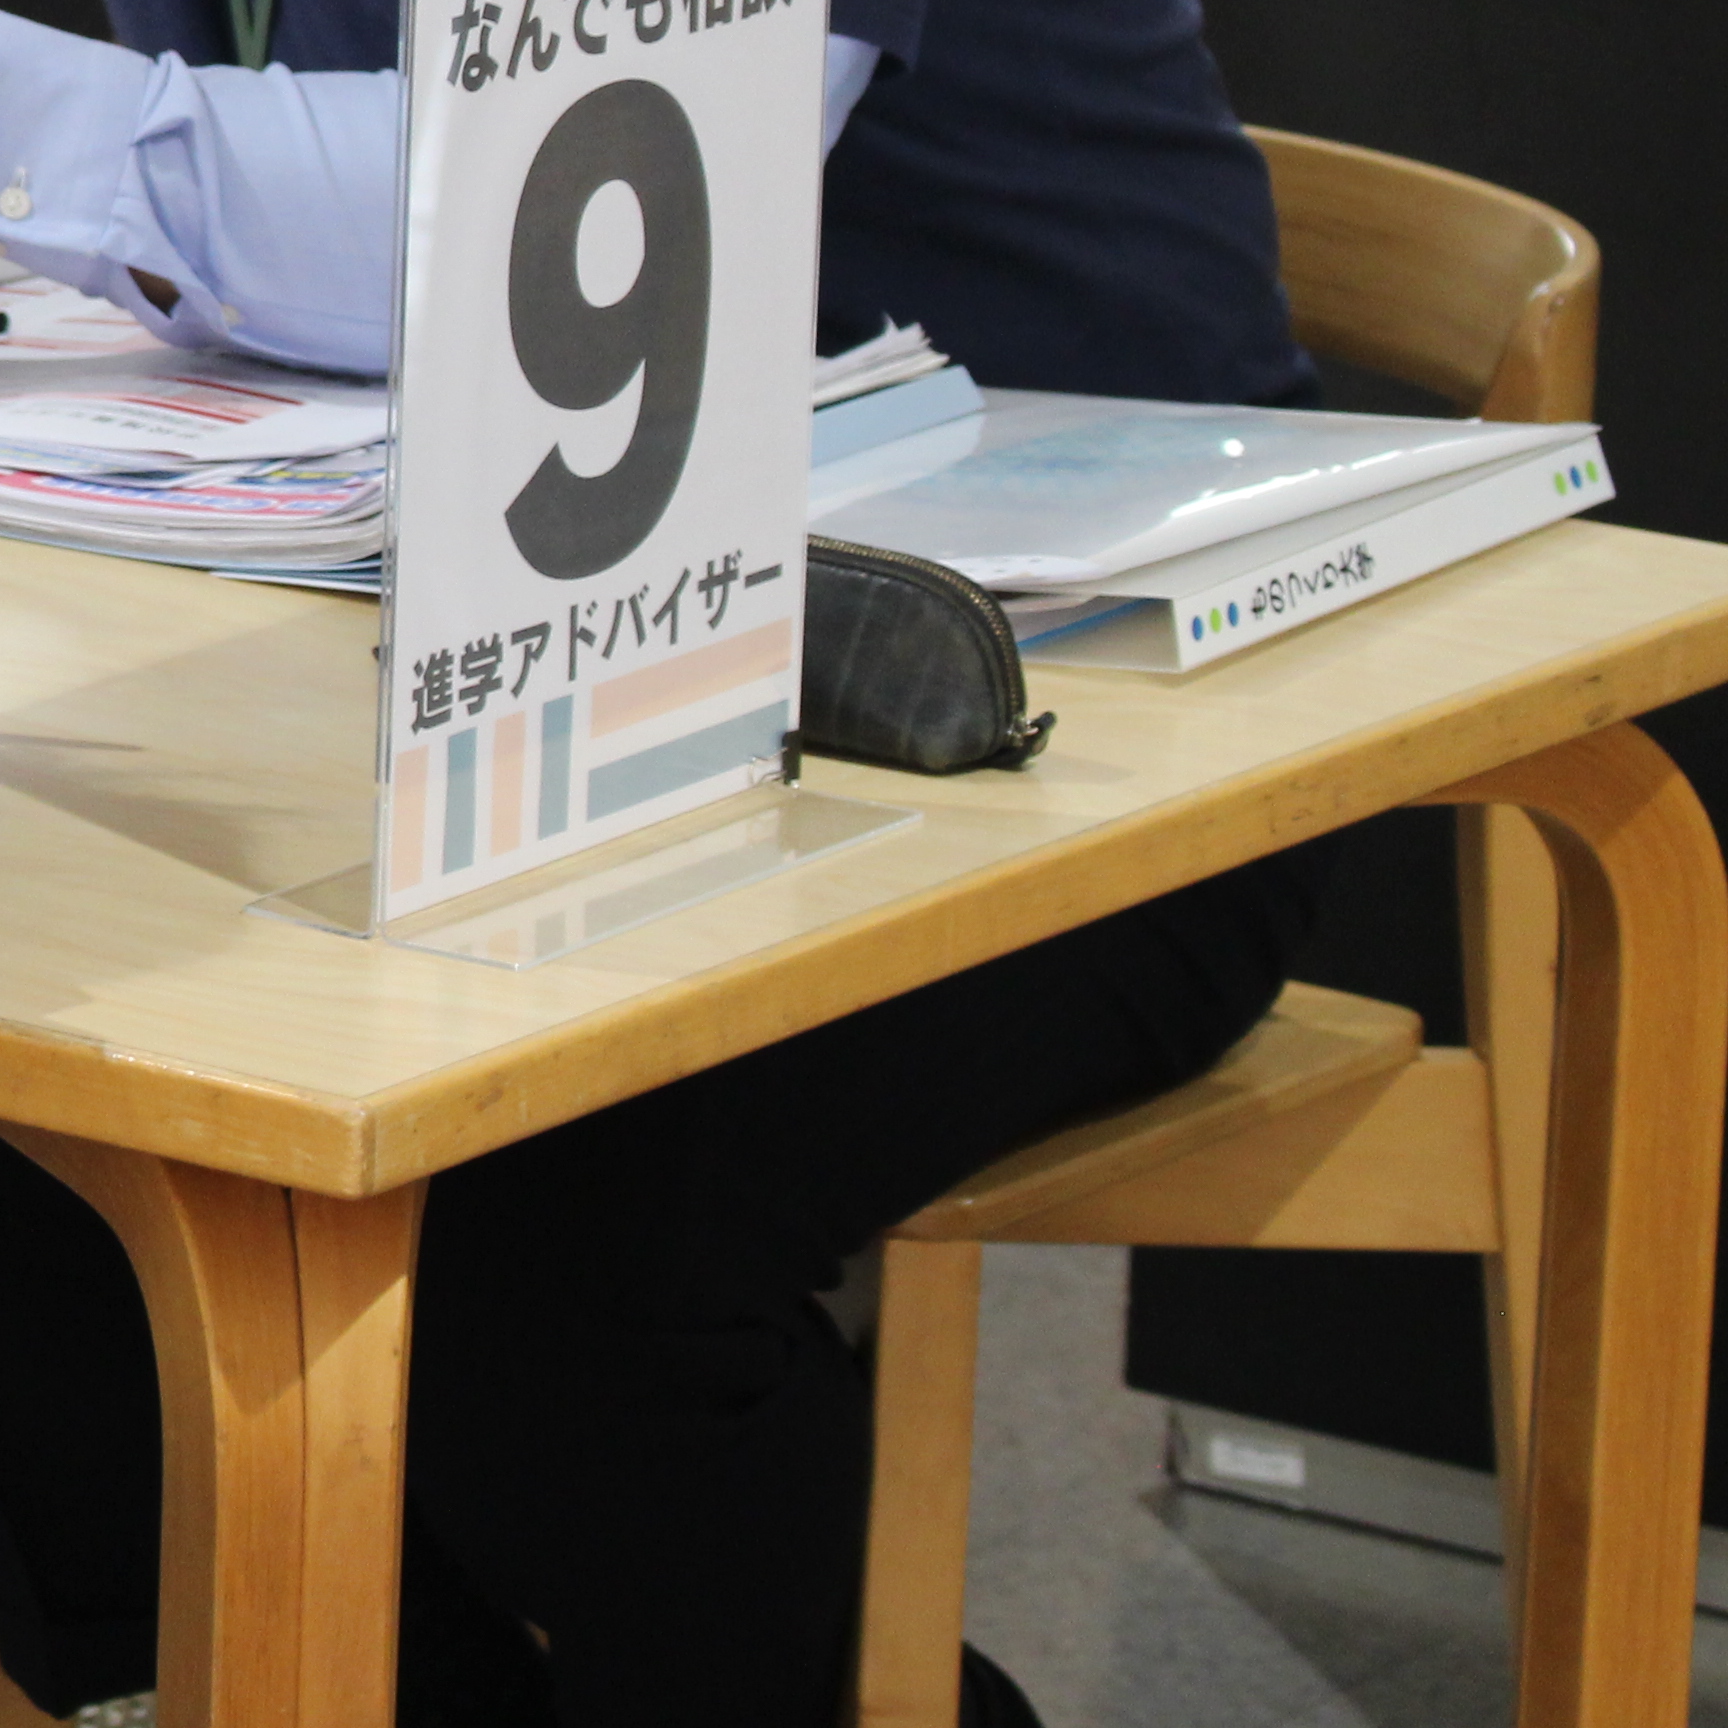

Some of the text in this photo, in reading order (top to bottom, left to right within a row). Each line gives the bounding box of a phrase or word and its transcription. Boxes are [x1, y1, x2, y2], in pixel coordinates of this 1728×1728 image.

[504, 78, 712, 580] 9
[410, 559, 783, 734] 進学アドバイザー
